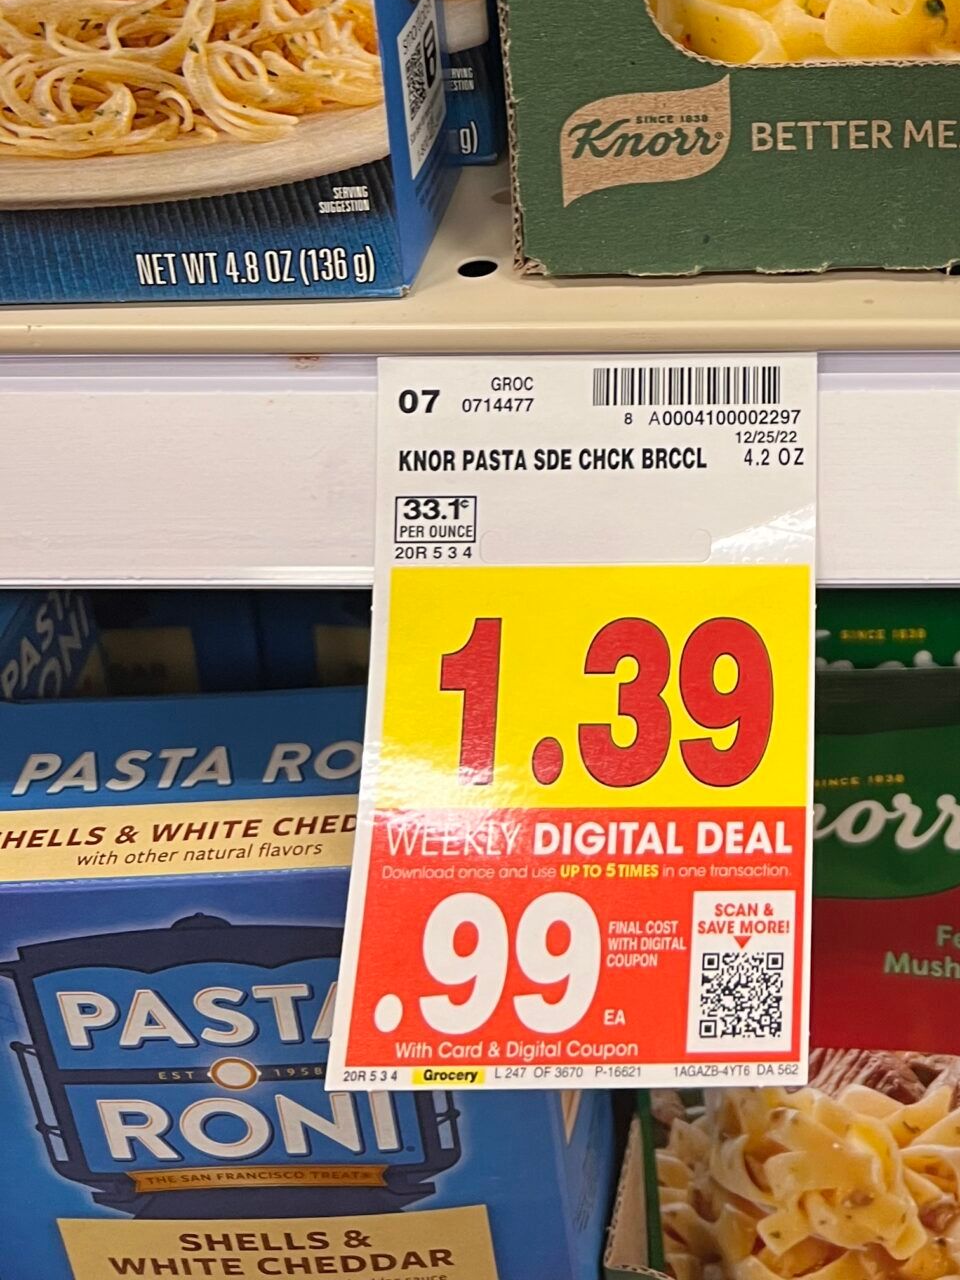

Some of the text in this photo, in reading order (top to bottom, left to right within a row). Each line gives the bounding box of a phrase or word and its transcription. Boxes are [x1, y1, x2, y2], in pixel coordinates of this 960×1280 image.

[751, 120, 894, 152] BETTER
[333, 185, 369, 199] SERVING
[318, 199, 371, 214] SUGGESTION
[135, 244, 376, 286] NET WT 4.8 OZ (136 g)
[491, 376, 535, 393] GROC
[399, 389, 535, 415] 07 0714477
[649, 409, 802, 427] A0004100002297
[735, 431, 798, 445] 12/25/22
[399, 446, 708, 472] KNOR PASTA SDE CHCK BRCCL
[743, 447, 805, 468] 4.2 OZ
[400, 524, 473, 539] PER OUNCE
[440, 616, 774, 788] 1.39
[11, 745, 233, 797] PASTA
[386, 820, 793, 857] WEEKLY DIGITAL DEAL
[76, 840, 323, 867] with other natural flavors
[382, 864, 455, 880] Download
[458, 867, 495, 880] once
[499, 864, 528, 879] and
[531, 867, 557, 879] use
[560, 863, 580, 879] UP
[582, 863, 602, 879] TO
[605, 862, 617, 878] 5
[618, 862, 660, 878] TIMES
[662, 863, 675, 878] in
[678, 866, 706, 878] one
[714, 902, 775, 918] SCAN &
[607, 919, 679, 935] FINAL COST
[697, 919, 791, 935] SAVE MORE!
[607, 936, 687, 951] WITH DIGITAL
[373, 890, 601, 1036] .99
[606, 953, 659, 968] COUPON
[603, 1008, 627, 1026] EA
[395, 1039, 639, 1062] With Card & Digital Coupon
[423, 1068, 478, 1084] Grocery
[504, 1066, 527, 1079] 247
[533, 1066, 552, 1079] OF
[554, 1066, 584, 1079] 3670
[595, 1065, 642, 1078] P-16621
[756, 1064, 775, 1076] DA
[777, 1063, 799, 1076] 562
[94, 1089, 403, 1162] RONI
[179, 1228, 372, 1253] SHELLS &
[108, 1256, 245, 1277] WHITE
[256, 1247, 455, 1275] CHEDDAR
